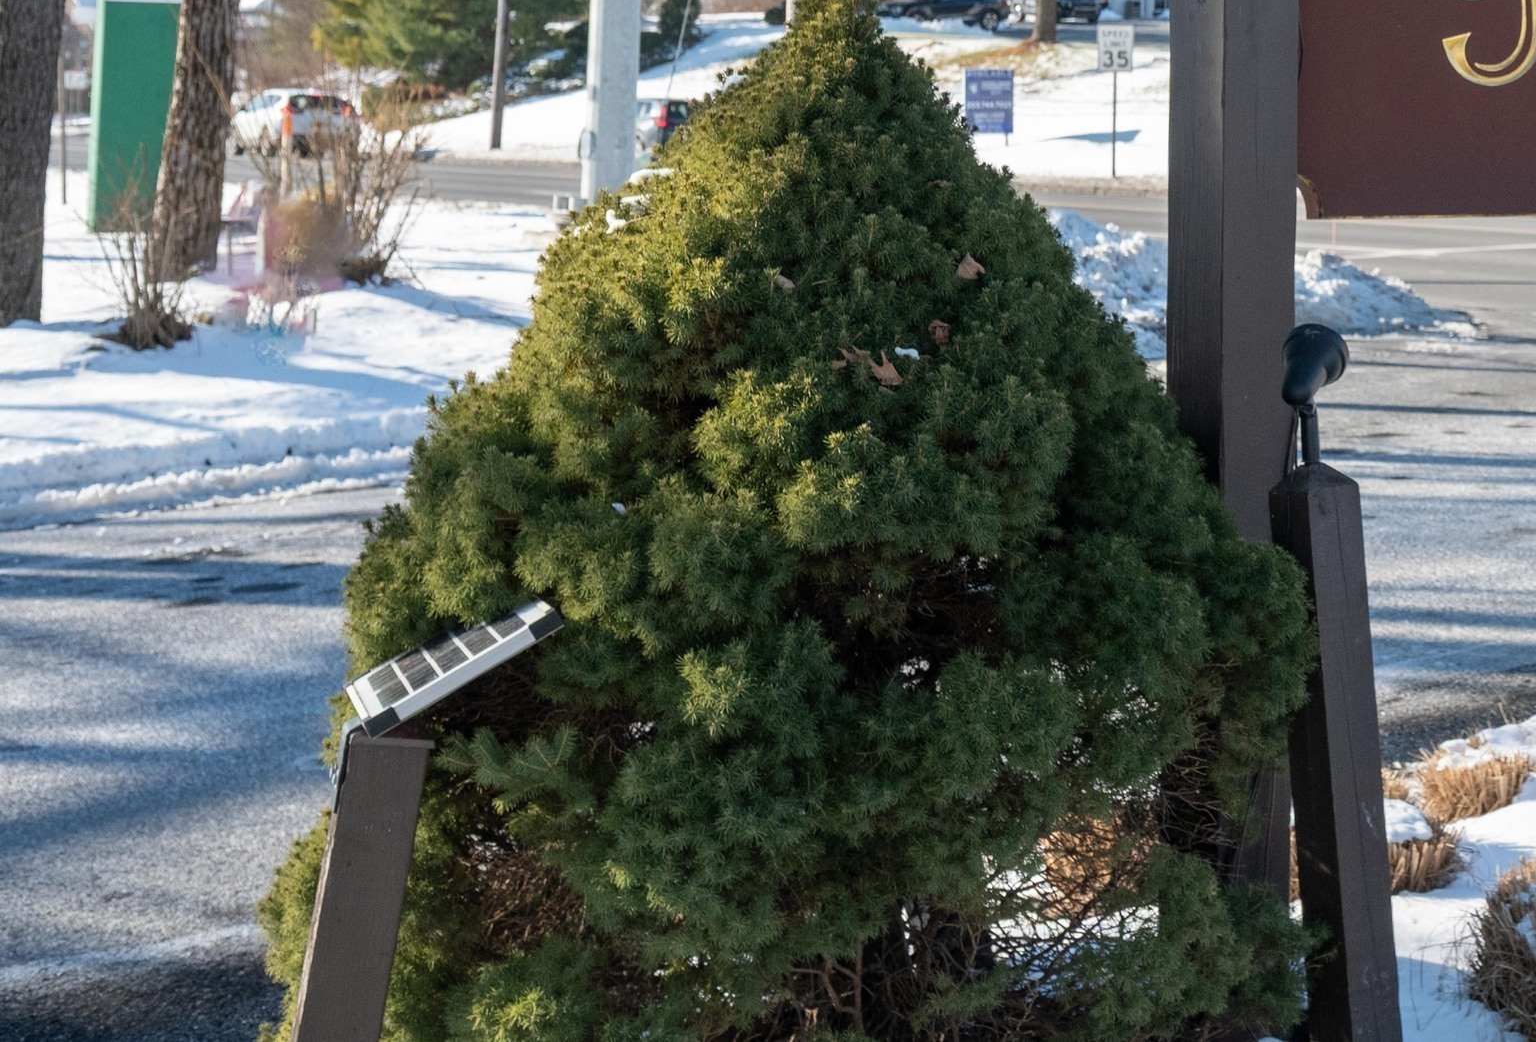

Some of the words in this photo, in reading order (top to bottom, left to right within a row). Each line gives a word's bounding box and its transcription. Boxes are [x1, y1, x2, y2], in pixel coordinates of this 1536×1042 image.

[1101, 30, 1129, 38] SPEED
[1103, 40, 1127, 48] LIMIT
[1103, 50, 1129, 68] 35
